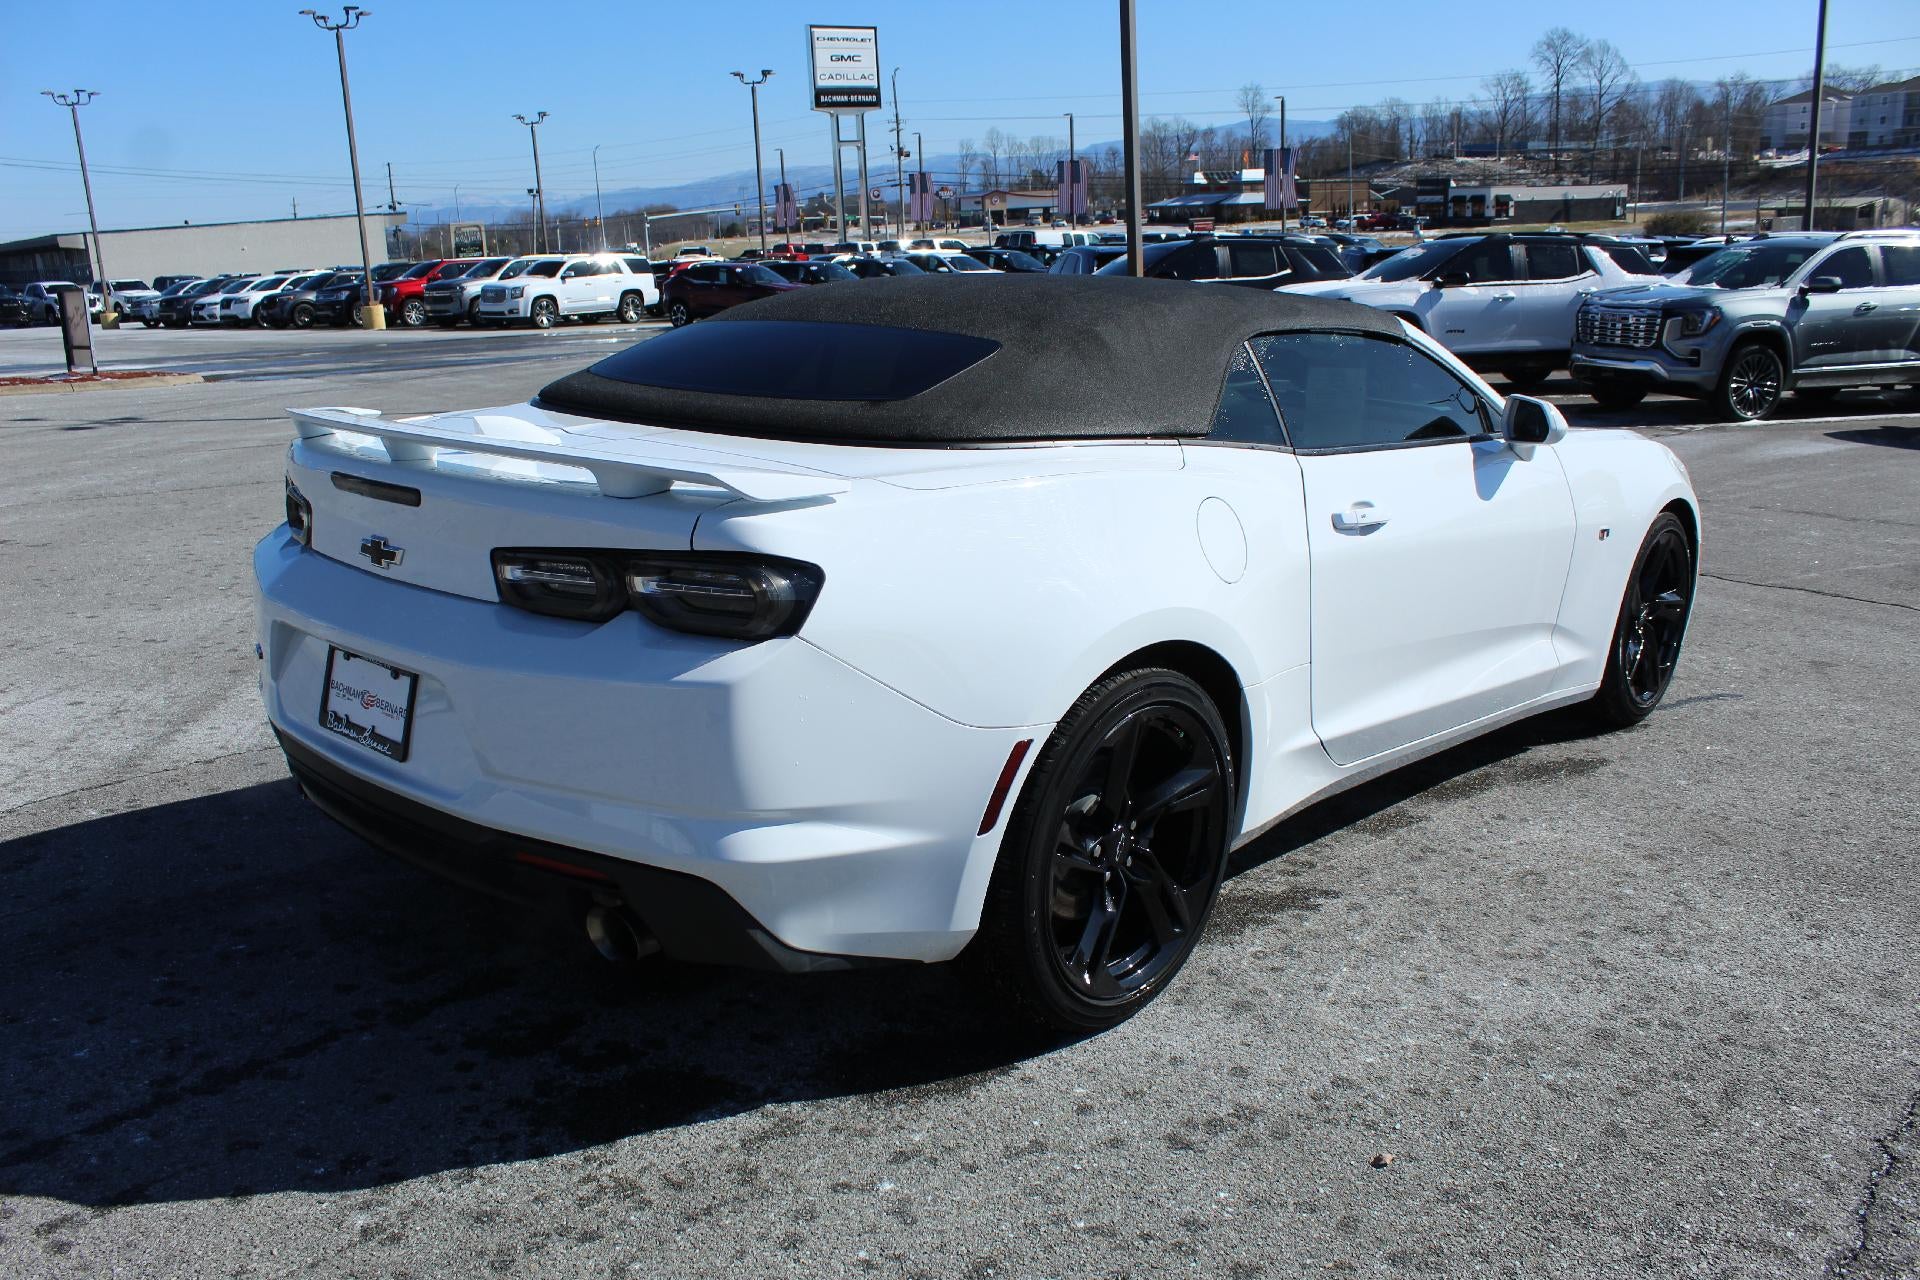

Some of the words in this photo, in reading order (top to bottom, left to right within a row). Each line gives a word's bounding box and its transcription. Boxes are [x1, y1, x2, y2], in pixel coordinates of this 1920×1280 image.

[830, 54, 862, 62] GMC
[819, 73, 875, 81] CADILLAC
[330, 679, 361, 699] BACHMAN
